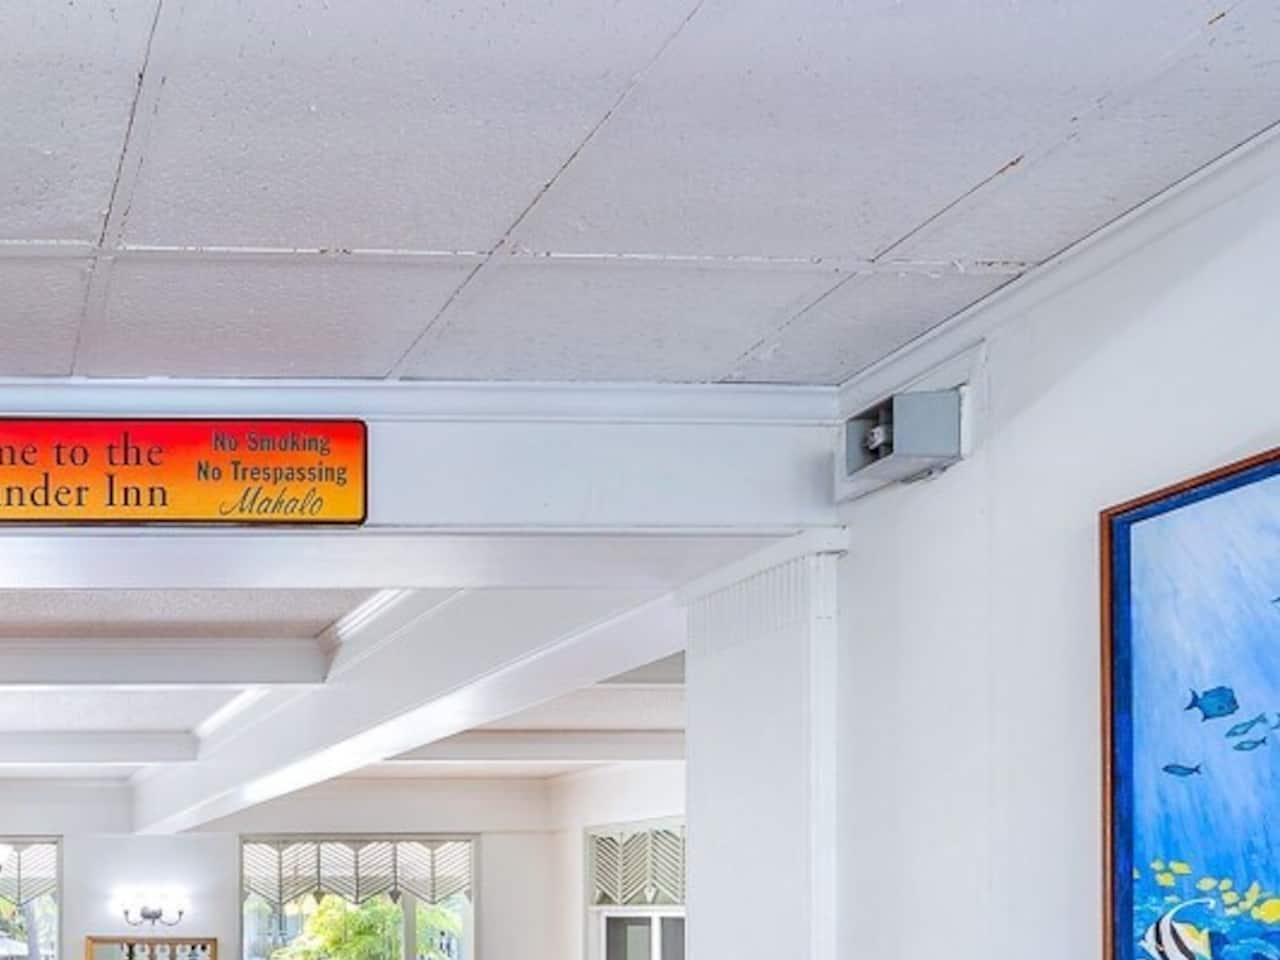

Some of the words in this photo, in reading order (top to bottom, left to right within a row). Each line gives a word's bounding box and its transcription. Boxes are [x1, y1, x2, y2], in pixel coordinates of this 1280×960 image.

[54, 440, 89, 467] to
[106, 431, 163, 467] the
[213, 431, 238, 451] No
[247, 431, 331, 455] Smoking
[197, 460, 222, 481] No
[231, 460, 348, 485] Trespassing
[105, 472, 169, 508] Inn
[220, 485, 324, 516] Mahalo
